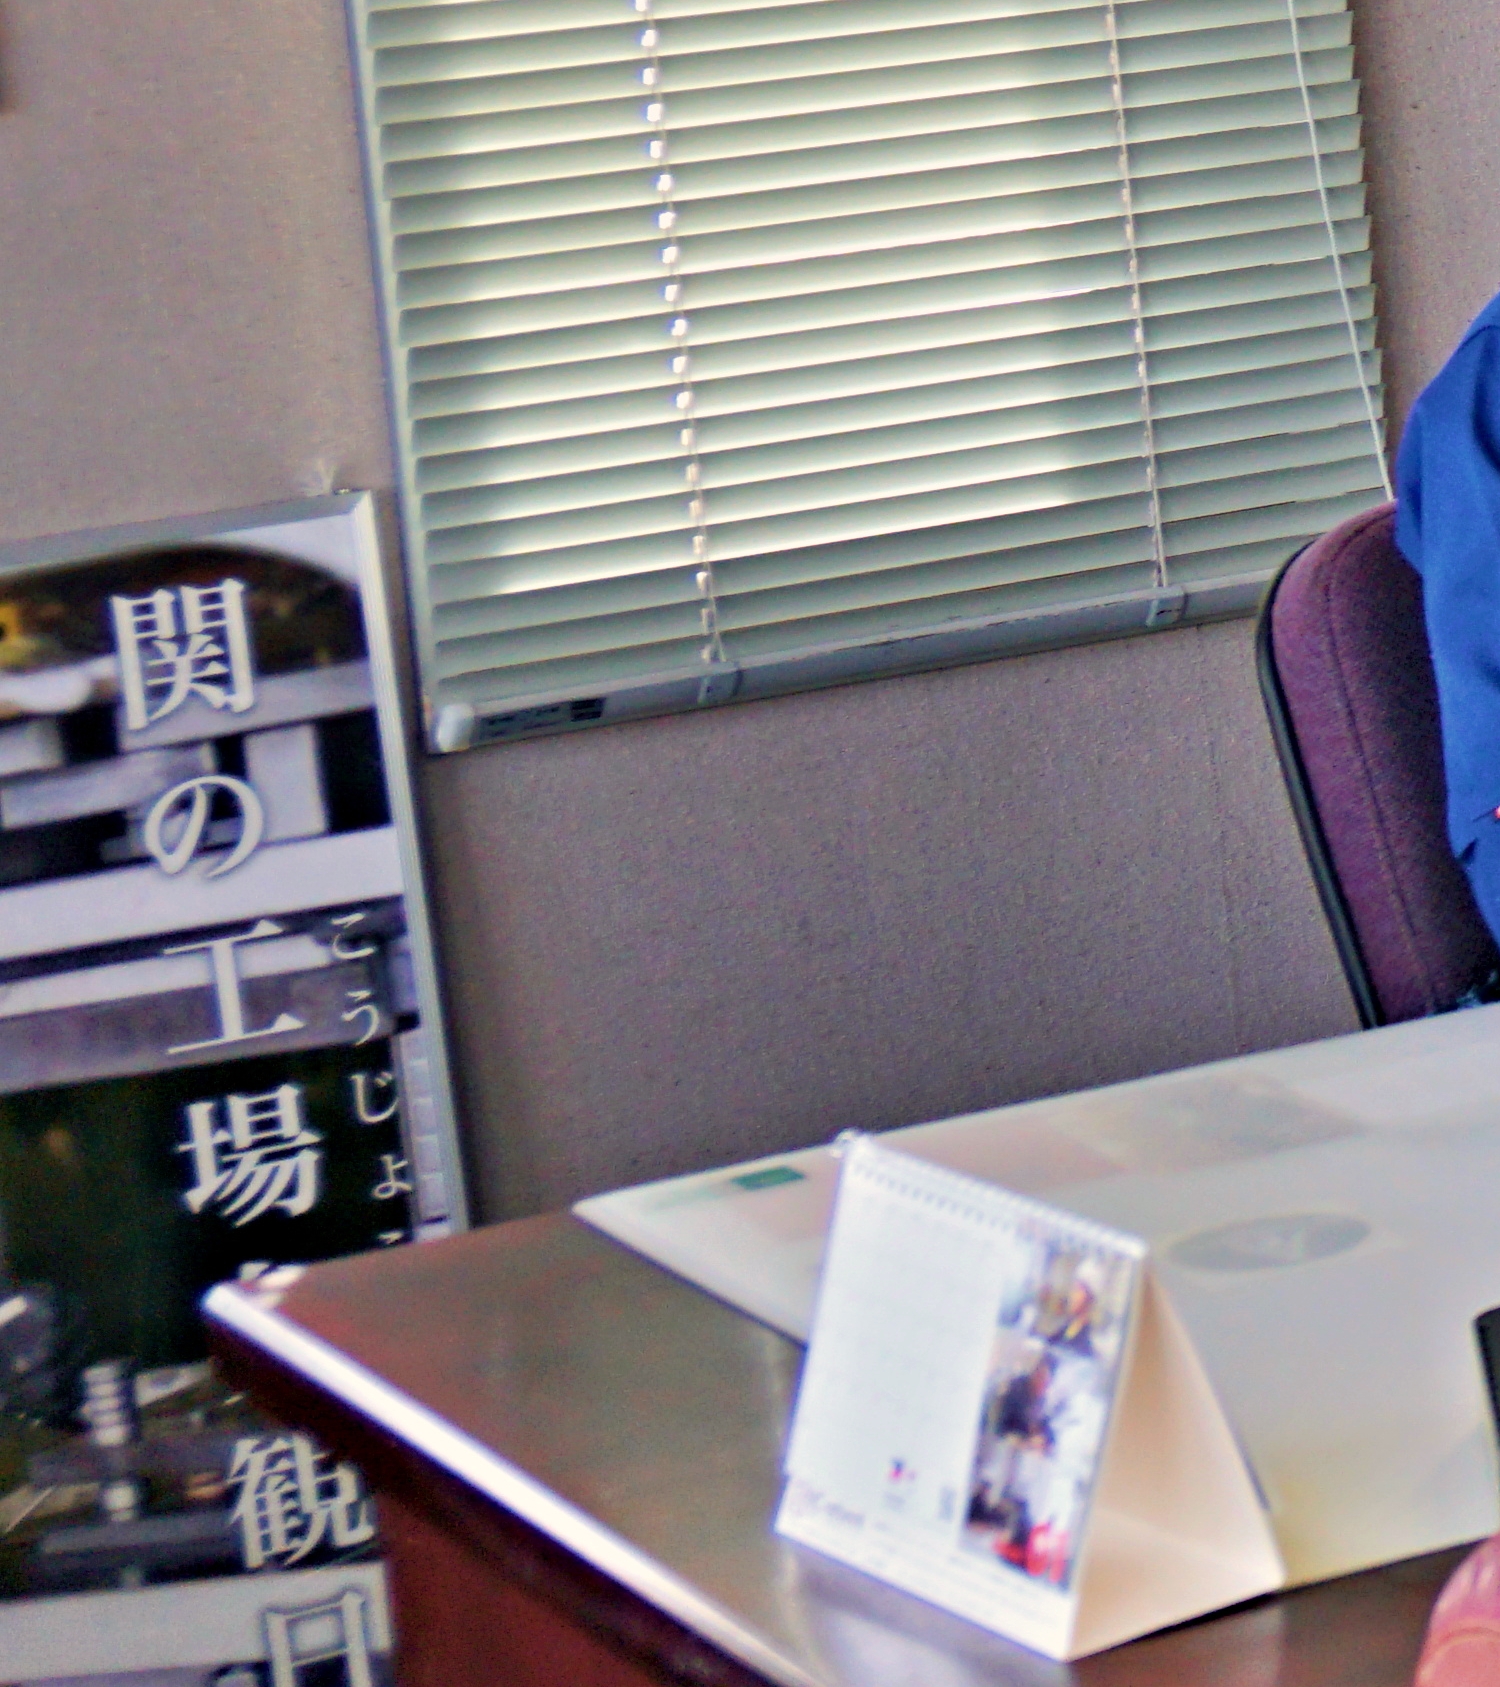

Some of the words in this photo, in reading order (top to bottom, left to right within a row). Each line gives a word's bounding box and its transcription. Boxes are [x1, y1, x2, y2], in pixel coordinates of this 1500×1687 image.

[109, 578, 376, 1687] 関の工場観日
